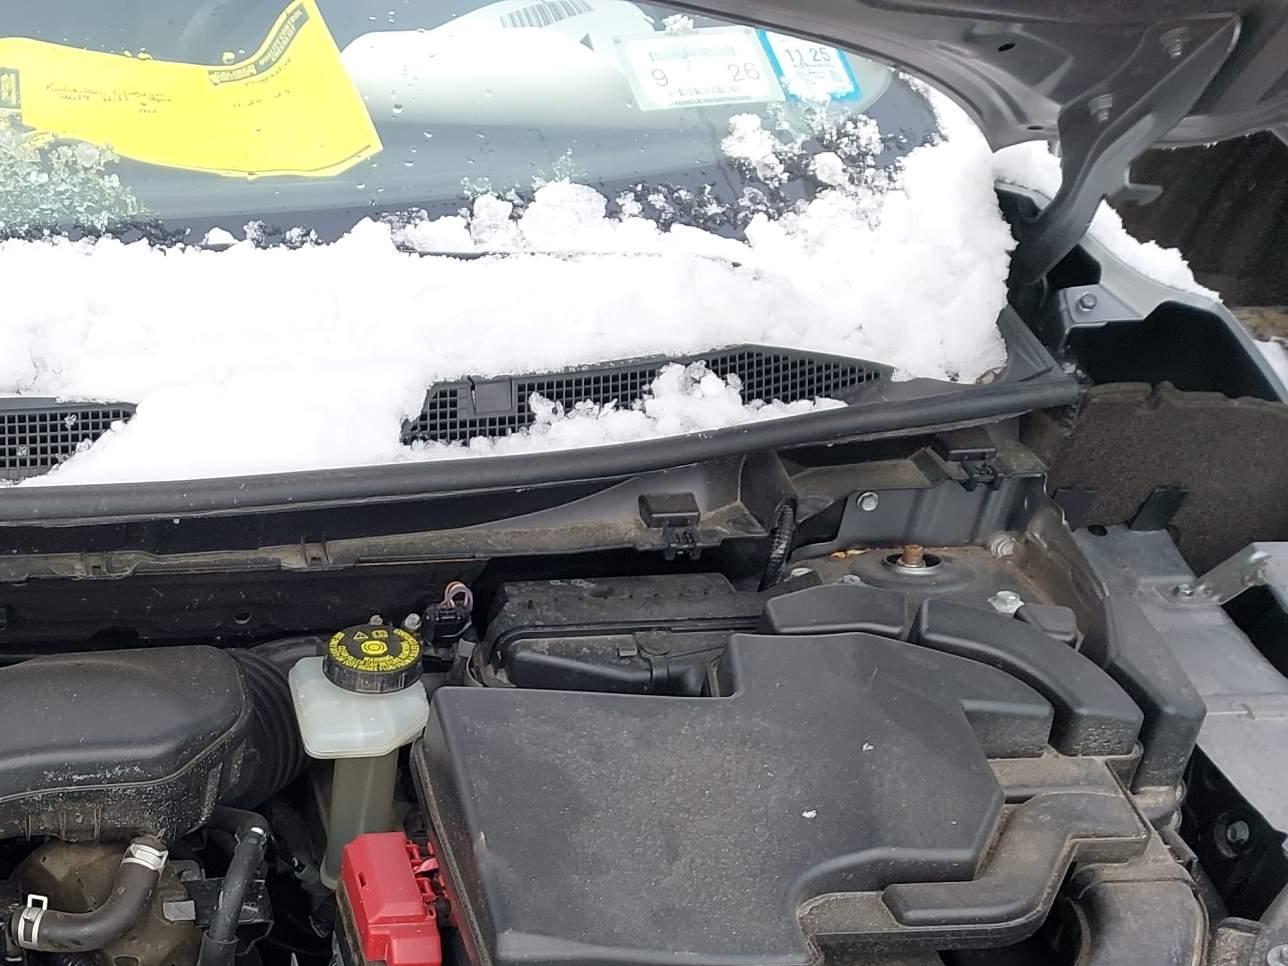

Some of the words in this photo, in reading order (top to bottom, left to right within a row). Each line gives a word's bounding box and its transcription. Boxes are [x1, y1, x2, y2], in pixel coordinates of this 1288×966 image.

[808, 47, 831, 62] 25
[651, 69, 669, 87] 9
[727, 62, 760, 82] 26
